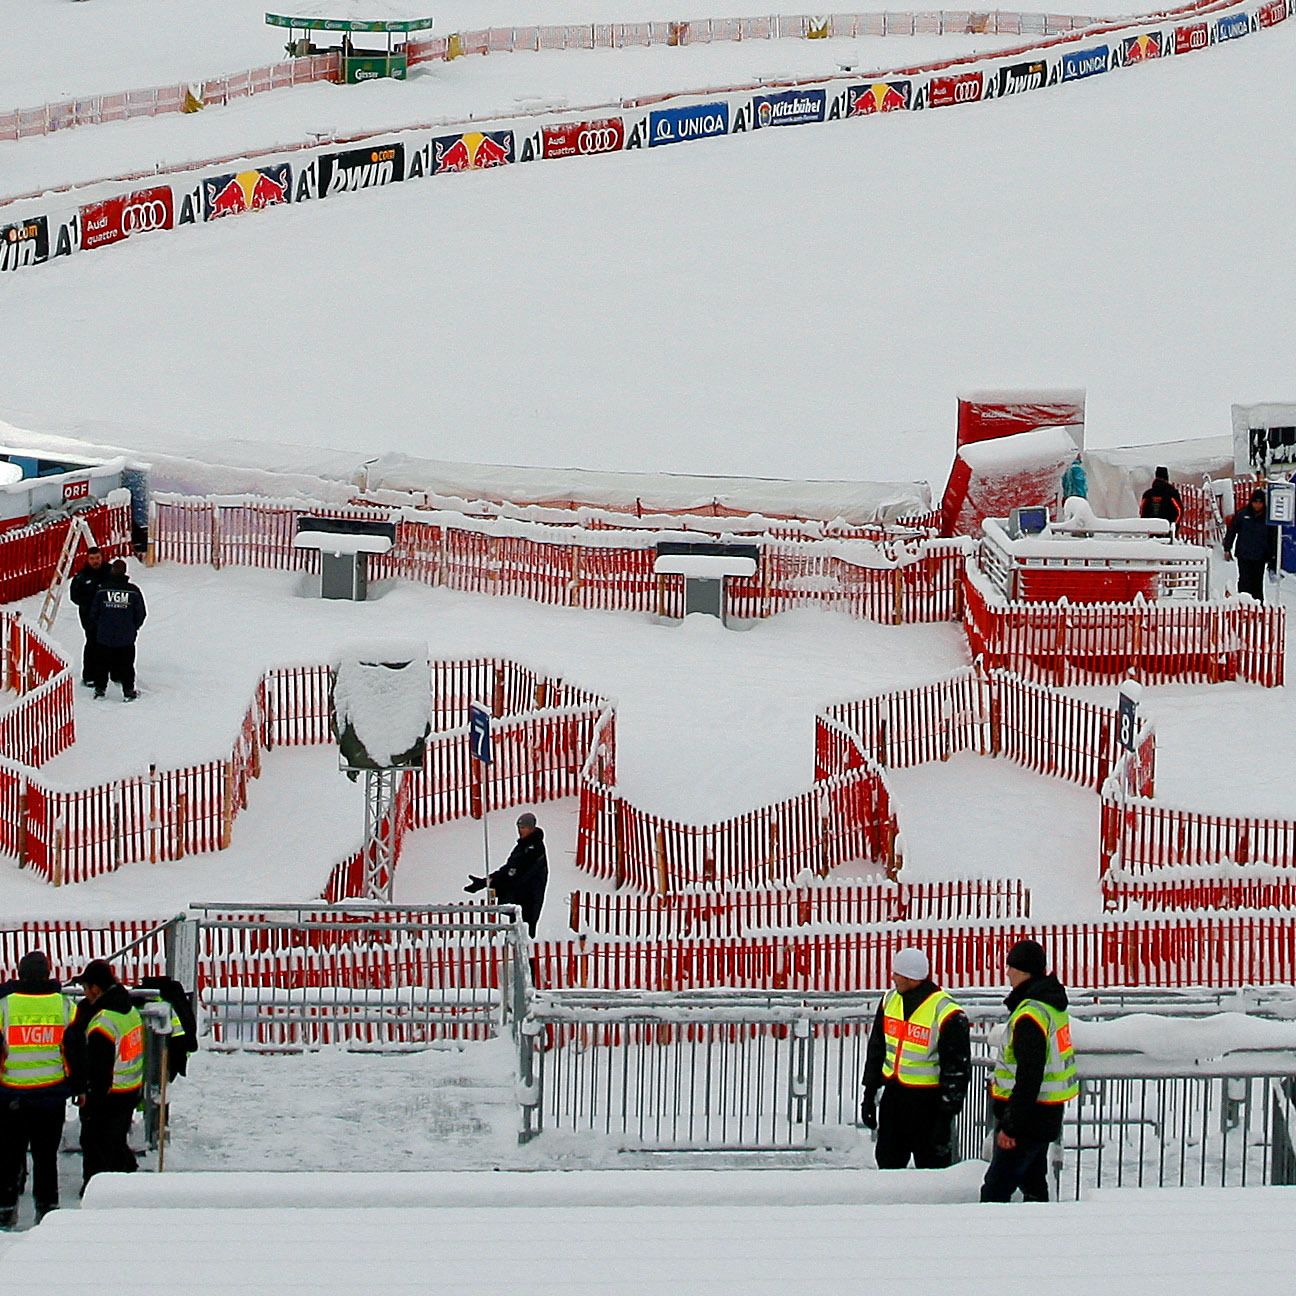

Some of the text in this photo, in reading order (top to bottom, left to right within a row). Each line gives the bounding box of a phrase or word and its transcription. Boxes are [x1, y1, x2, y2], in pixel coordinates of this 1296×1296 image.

[912, 83, 929, 111] A1
[984, 72, 999, 100] A1
[1005, 70, 1042, 96] bwin
[732, 102, 752, 134] A1
[772, 98, 821, 117] Kitzbühel
[828, 91, 846, 121] A1
[625, 117, 647, 150] A1
[678, 115, 725, 137] UNIQA
[520, 131, 540, 163] A1
[547, 136, 566, 146] Audi
[547, 147, 576, 158] quattro
[407, 144, 429, 179] A1
[295, 161, 316, 202] A1
[326, 159, 394, 194] bwin
[178, 185, 201, 225] A1
[55, 215, 79, 256] A1
[87, 216, 109, 231] Audi
[87, 229, 118, 245] quattro
[64, 484, 87, 498] ORF
[107, 591, 129, 603] VGM
[474, 725, 485, 756] 7
[1121, 714, 1130, 745] 8
[21, 1027, 55, 1043] VGM
[908, 1024, 929, 1040] VGM
